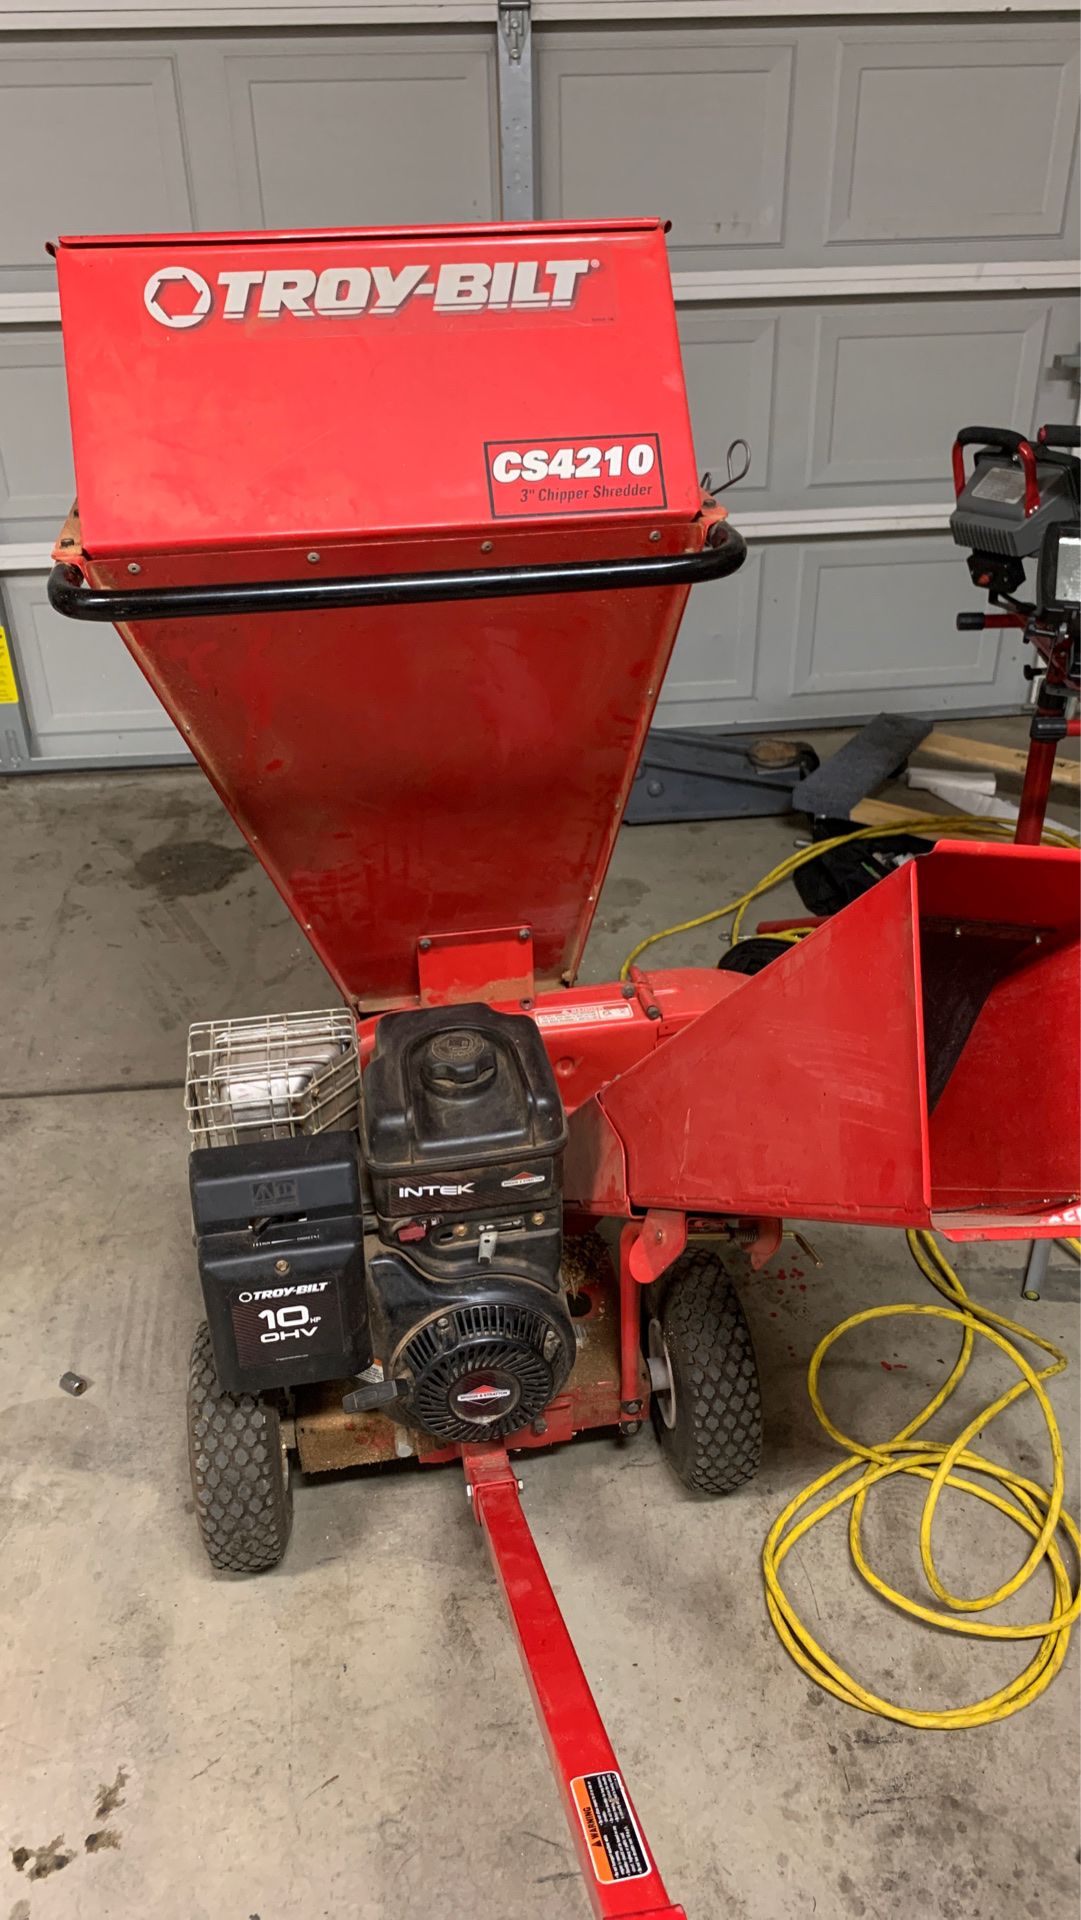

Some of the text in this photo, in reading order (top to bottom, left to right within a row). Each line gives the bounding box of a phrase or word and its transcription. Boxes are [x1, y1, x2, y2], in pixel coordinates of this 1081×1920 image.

[217, 259, 590, 320] TROY-BILT
[492, 444, 655, 484] CS4210
[520, 483, 653, 504] 3" Chipper Shredder
[399, 1182, 476, 1198] INTEK
[253, 1281, 329, 1301] TROY-BILT
[257, 1305, 322, 1330] 10 HP
[260, 1326, 318, 1343] OHV
[583, 1806, 599, 1840] WARNING
